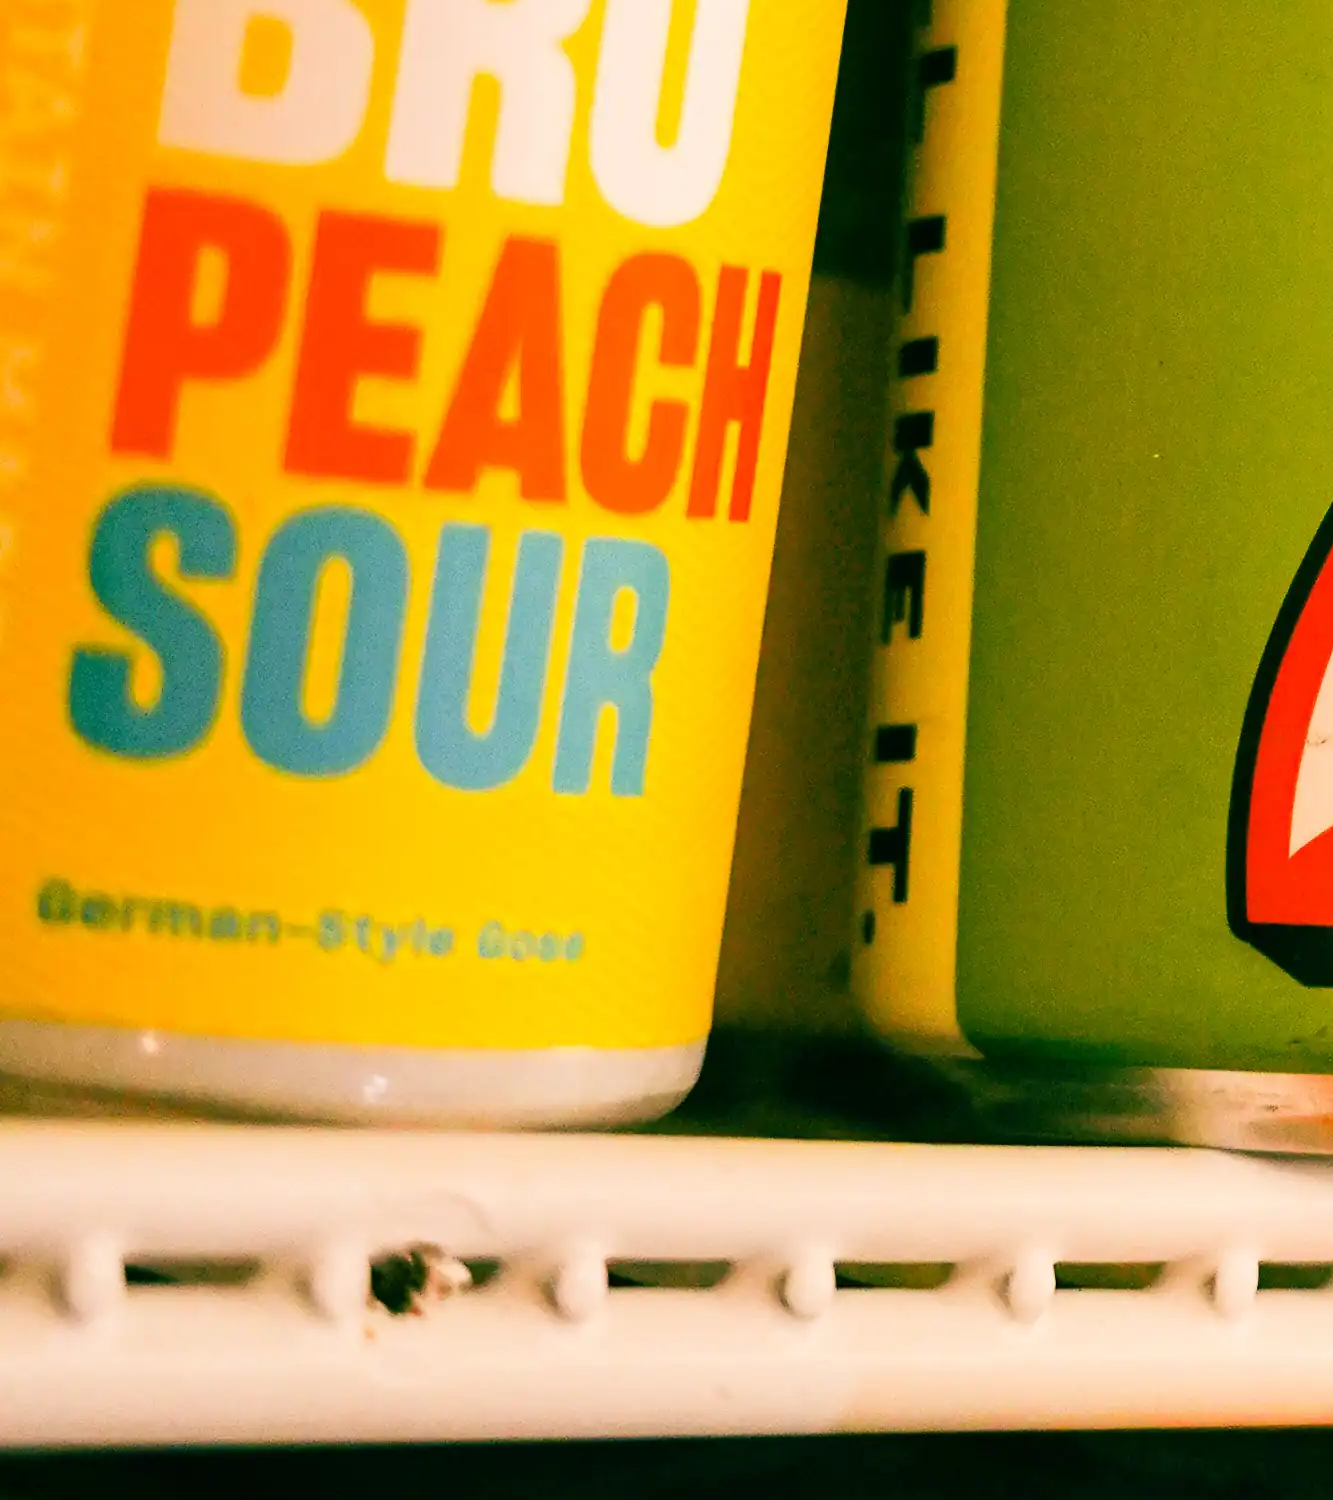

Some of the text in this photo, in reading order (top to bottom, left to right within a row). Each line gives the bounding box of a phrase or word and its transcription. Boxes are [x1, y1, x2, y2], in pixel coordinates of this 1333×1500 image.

[109, 183, 783, 524] PEACH
[870, 210, 948, 648] LIKE
[67, 480, 673, 799] SOUR
[36, 876, 586, 966] German-Style Gose
